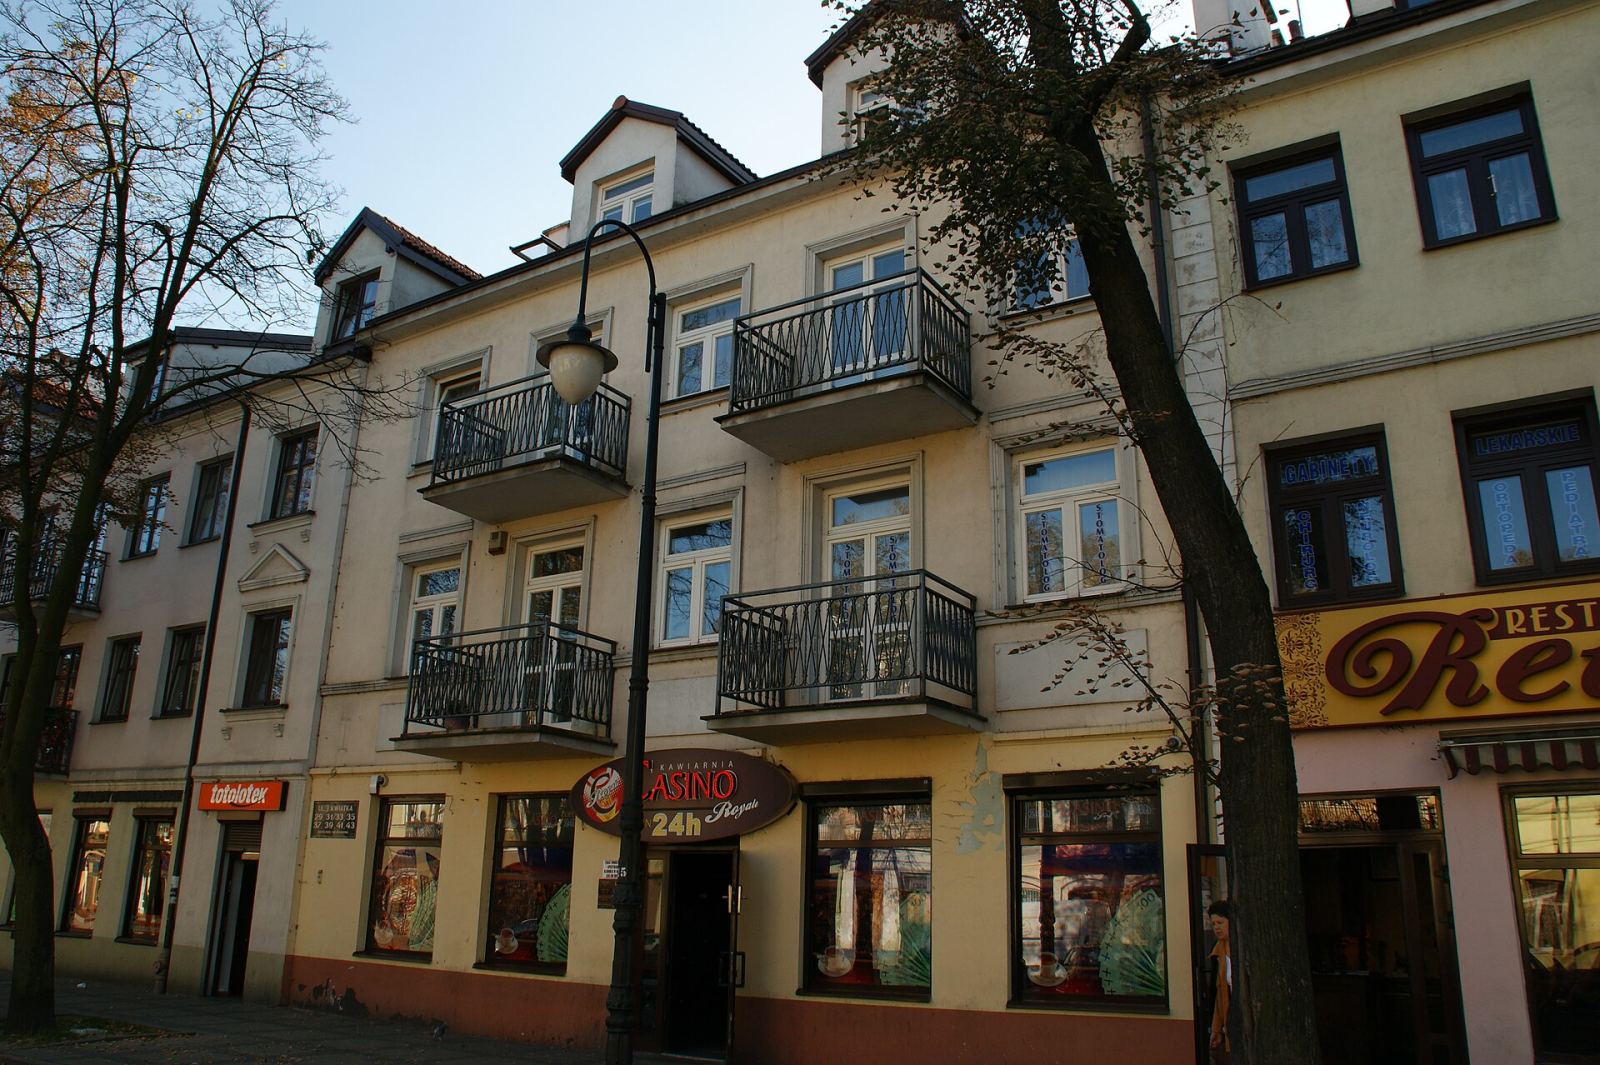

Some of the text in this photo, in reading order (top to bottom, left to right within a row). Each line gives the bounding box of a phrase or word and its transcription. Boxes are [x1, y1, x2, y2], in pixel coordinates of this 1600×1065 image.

[1475, 423, 1581, 456] LEKARSKIE
[1285, 455, 1375, 485] GABINETY
[1493, 482, 1518, 566] ORTOPEDA
[1561, 471, 1589, 557] PEDIATRA
[1040, 513, 1051, 592] STOMATOLOG
[1095, 503, 1107, 584] STOMATOLOG
[1296, 510, 1319, 590] CHIRURG
[1504, 602, 1598, 636] REST
[1325, 606, 1600, 716] Re
[210, 783, 269, 804] totolotek
[659, 760, 734, 771] KAWIARNIA
[651, 812, 701, 837] 24h
